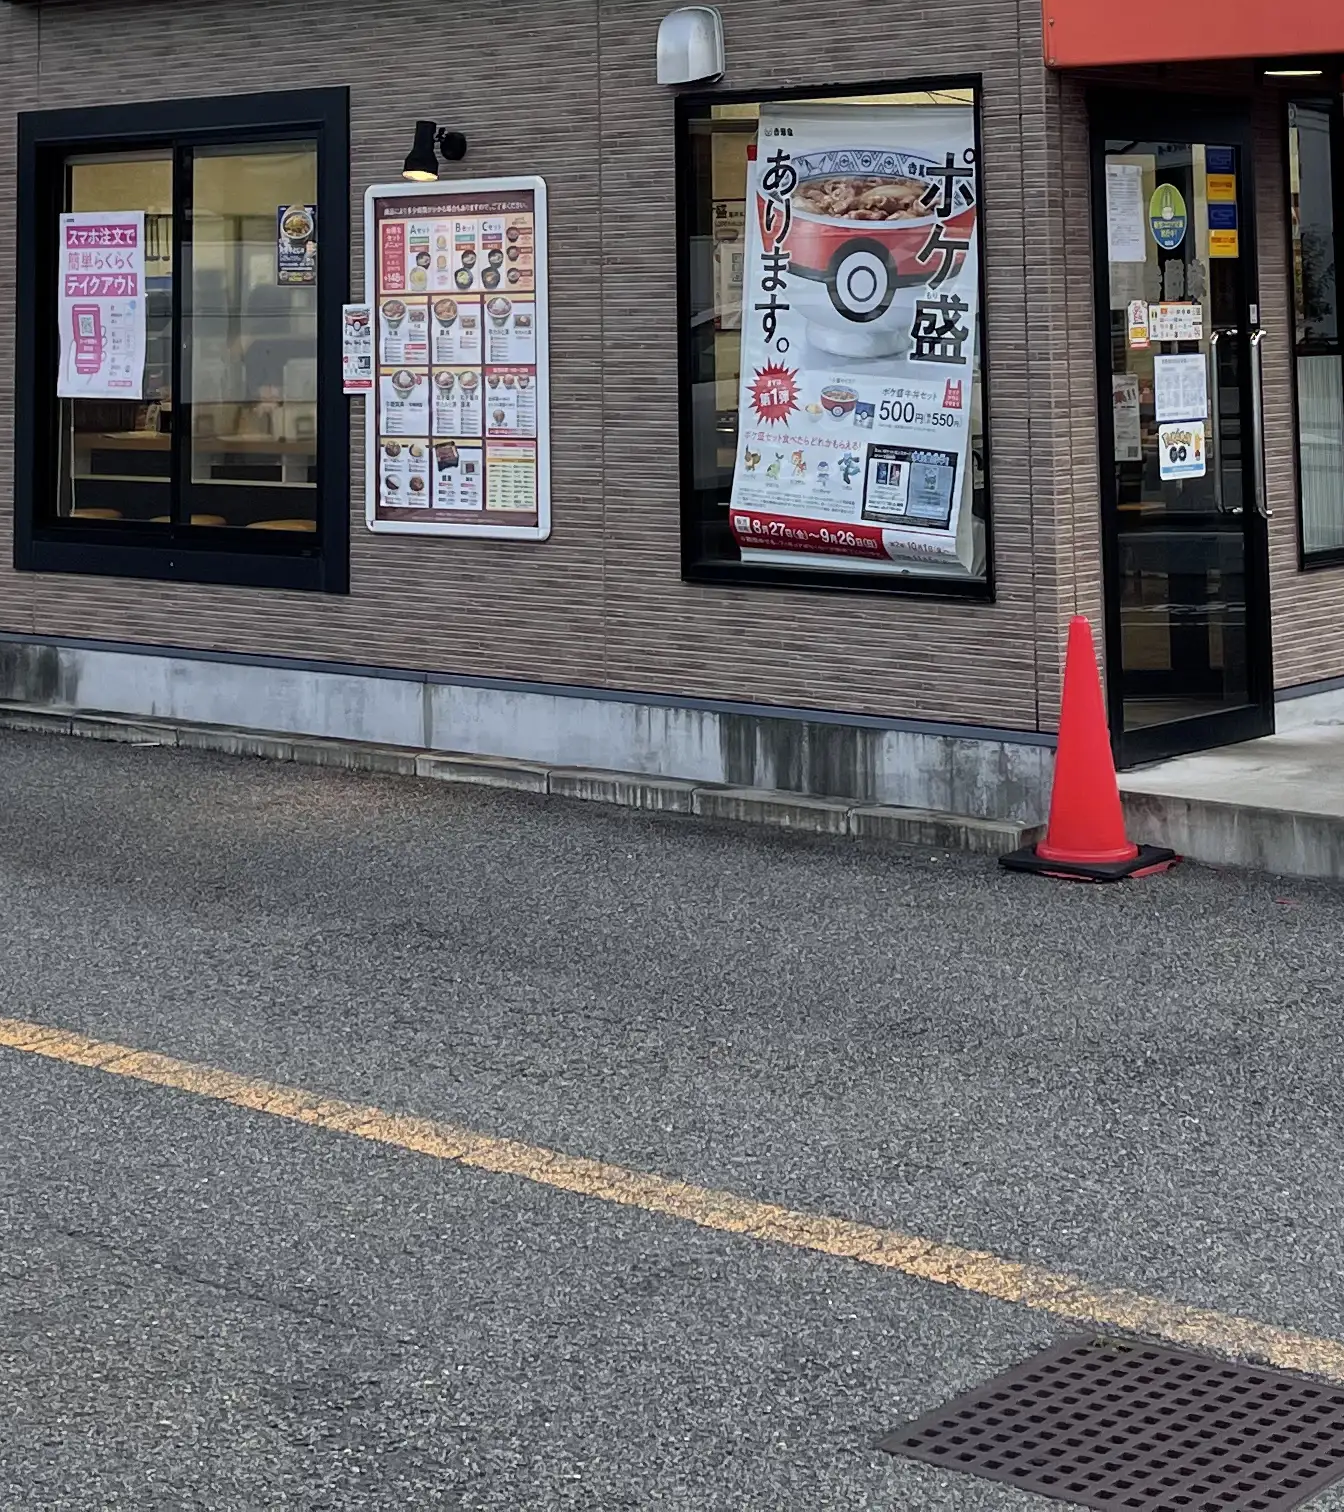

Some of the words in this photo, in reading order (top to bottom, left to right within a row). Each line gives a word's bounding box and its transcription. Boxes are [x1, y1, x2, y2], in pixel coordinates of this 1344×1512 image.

[67, 227, 136, 246] スマホ注文で
[67, 251, 135, 271] 簡単らくらく
[754, 148, 798, 353] あります。
[910, 147, 976, 365] ポケ盛
[67, 275, 136, 296] テイクアウト
[878, 399, 924, 425] 500円
